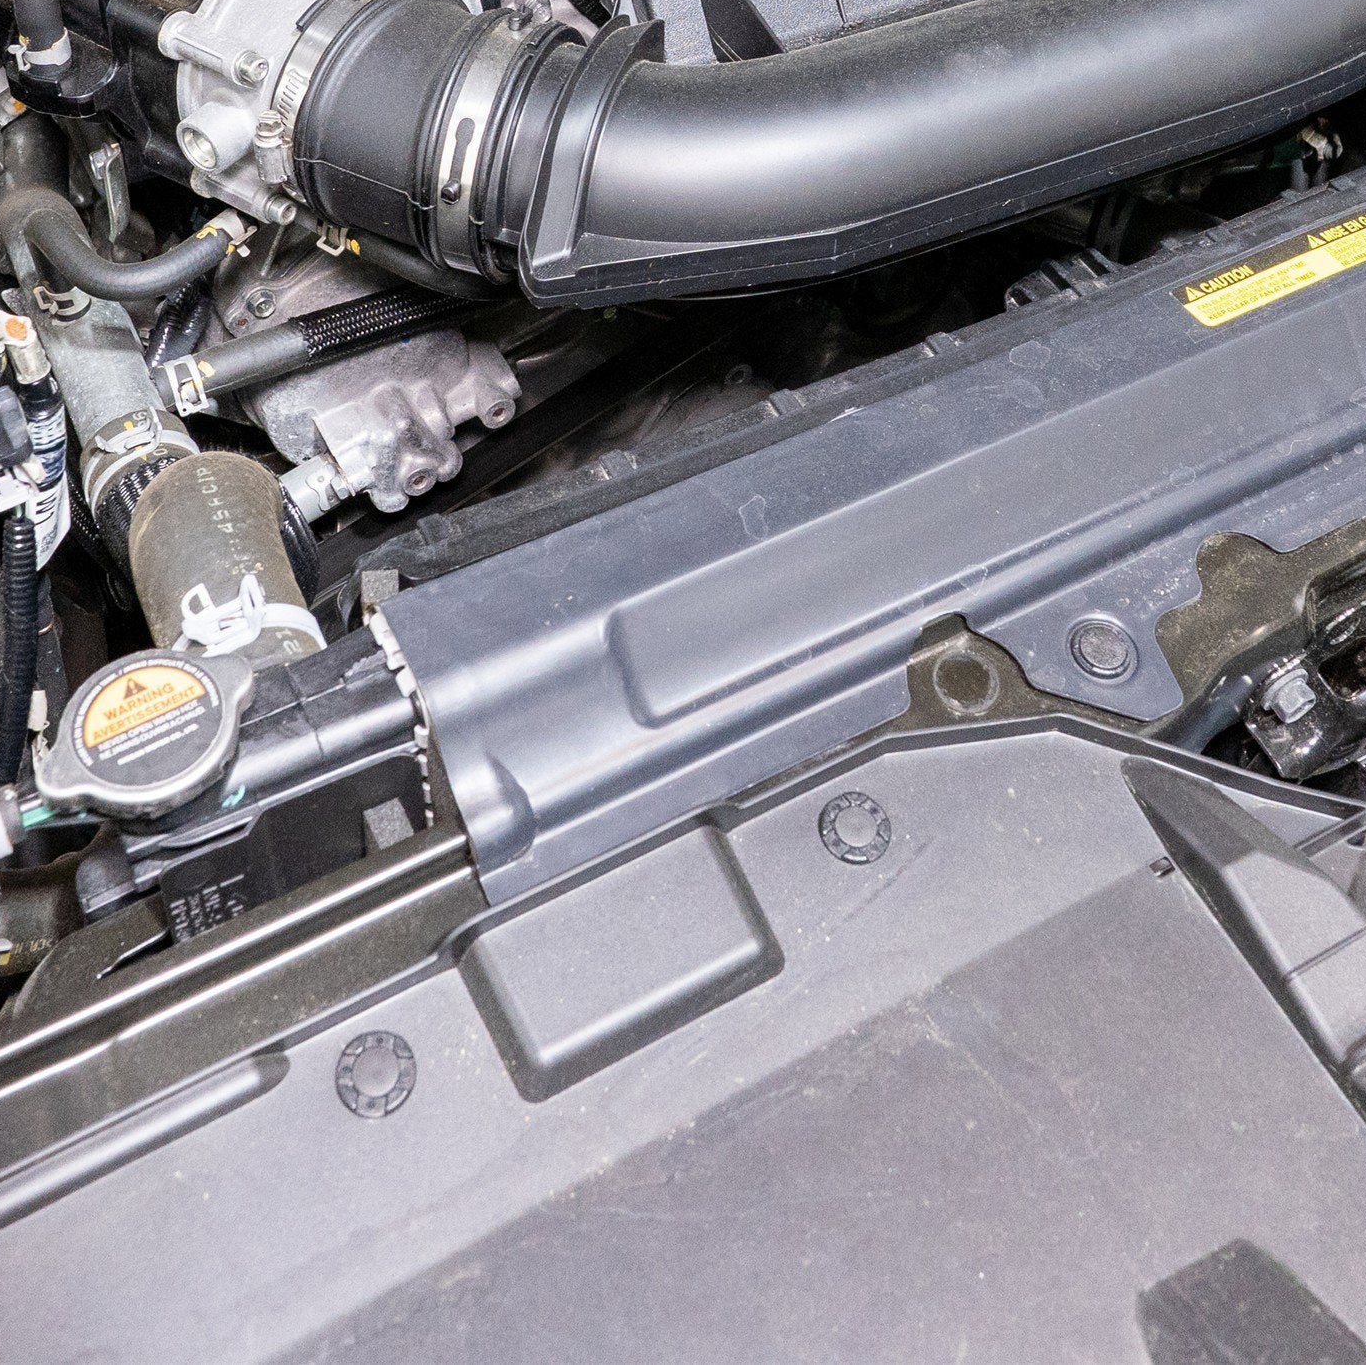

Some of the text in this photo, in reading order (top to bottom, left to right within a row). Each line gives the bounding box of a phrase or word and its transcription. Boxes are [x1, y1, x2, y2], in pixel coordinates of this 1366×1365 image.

[1318, 224, 1350, 241] MISE
[1341, 218, 1364, 231] EN
[1199, 266, 1254, 292] CAUTION
[1208, 310, 1228, 320] KEEP
[1226, 300, 1250, 311] CLEAR
[1259, 289, 1275, 298] FAN
[1282, 280, 1296, 288] ALL
[1294, 271, 1317, 282] TIMES
[90, 685, 197, 740] AVERTISSEMENT
[102, 682, 174, 721] WARNING
